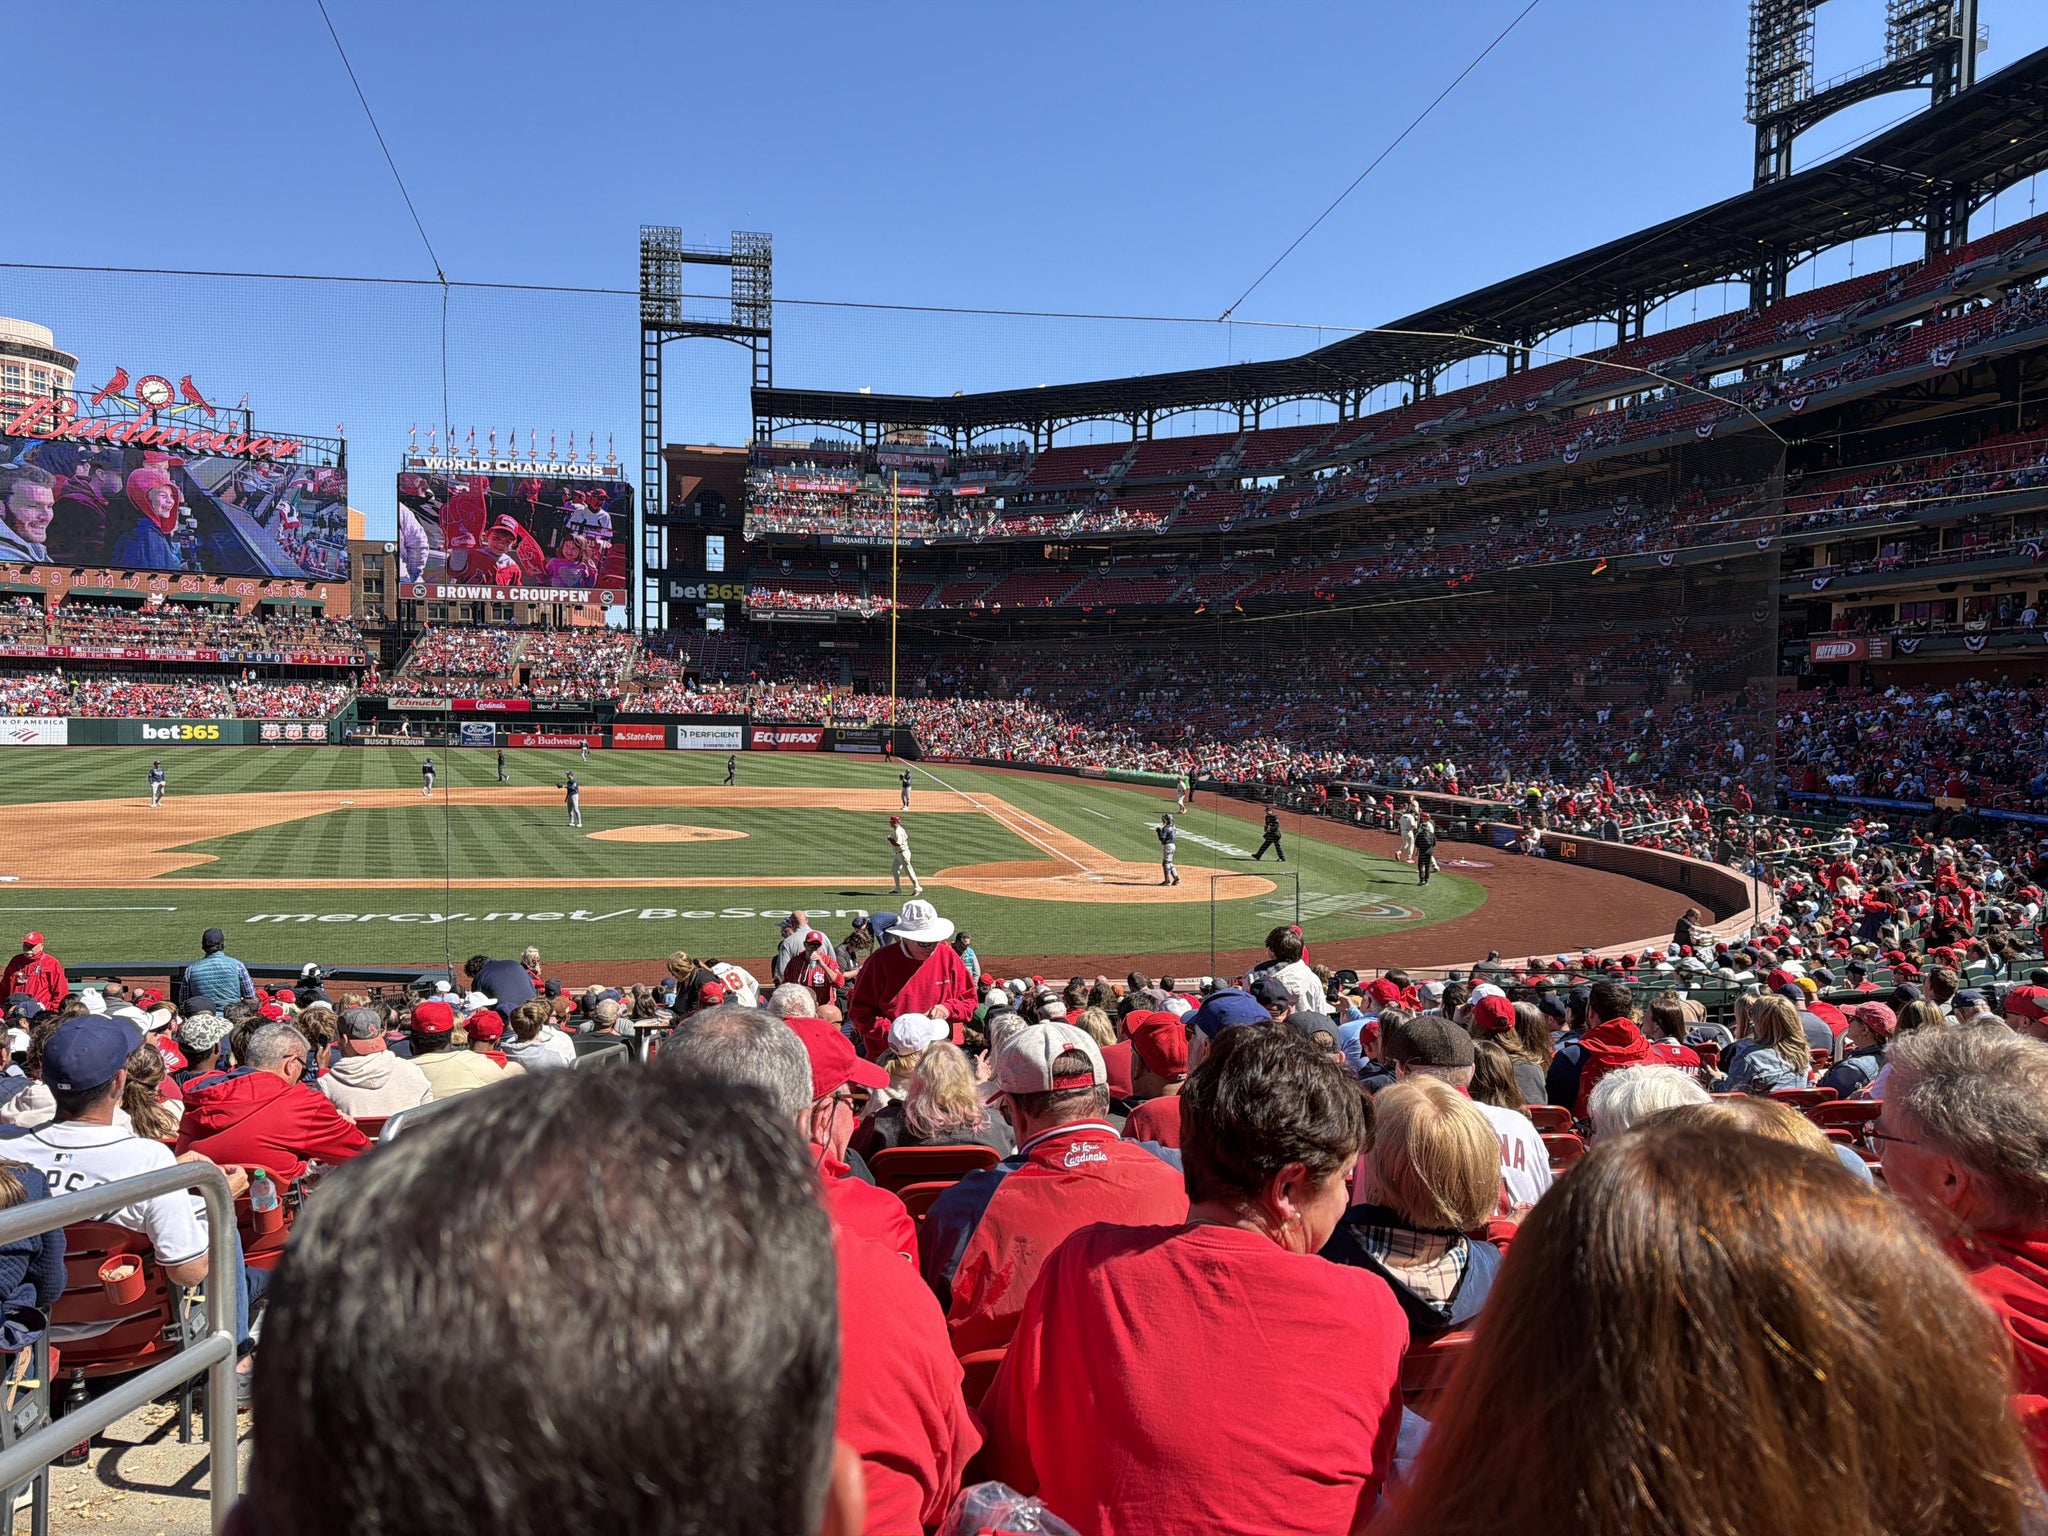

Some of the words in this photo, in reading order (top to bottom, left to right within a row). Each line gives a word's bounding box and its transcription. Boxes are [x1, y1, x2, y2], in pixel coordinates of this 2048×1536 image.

[0, 391, 303, 458] Budweiser
[905, 455, 946, 464] BUDWEISER
[423, 456, 491, 471] WORLD
[495, 460, 604, 476] CHAMPIONS
[832, 535, 868, 544] BENJAMIN
[9, 570, 21, 583] 2
[29, 571, 41, 585] 6
[51, 572, 62, 586] 9
[71, 574, 88, 587] 10
[97, 574, 114, 588] 14
[124, 576, 140, 590] 17
[150, 578, 169, 591] 20
[181, 579, 200, 593] 23
[208, 581, 227, 594] 24
[236, 583, 254, 596] 42
[264, 584, 282, 598] 45
[288, 585, 307, 598] 85
[437, 585, 492, 599] BROWN
[496, 590, 506, 600] &
[509, 588, 591, 603] CROUPPEN
[669, 581, 743, 600] bet365
[51, 648, 64, 656] 1-2
[126, 650, 140, 658] 0-2
[1815, 644, 1851, 656] HOFFMANN
[200, 652, 211, 660] 1-2
[238, 653, 244, 661] 0
[256, 653, 262, 662] 0
[274, 654, 280, 662] 0
[303, 655, 309, 663] 2
[320, 655, 326, 664] 3
[338, 656, 342, 664] 1
[349, 656, 355, 664] 6
[392, 698, 444, 707] Schnucks
[475, 700, 506, 711] Cardinals
[142, 723, 220, 741] bet365
[467, 723, 488, 733] Ford
[364, 738, 389, 746] BUSCH
[391, 738, 425, 746] STADIUM
[537, 736, 586, 745] Budweise
[753, 731, 818, 746] EQUIFAX
[244, 907, 870, 924] mercy.net/BeSeen
[1064, 1150, 1108, 1168] Cardinals
